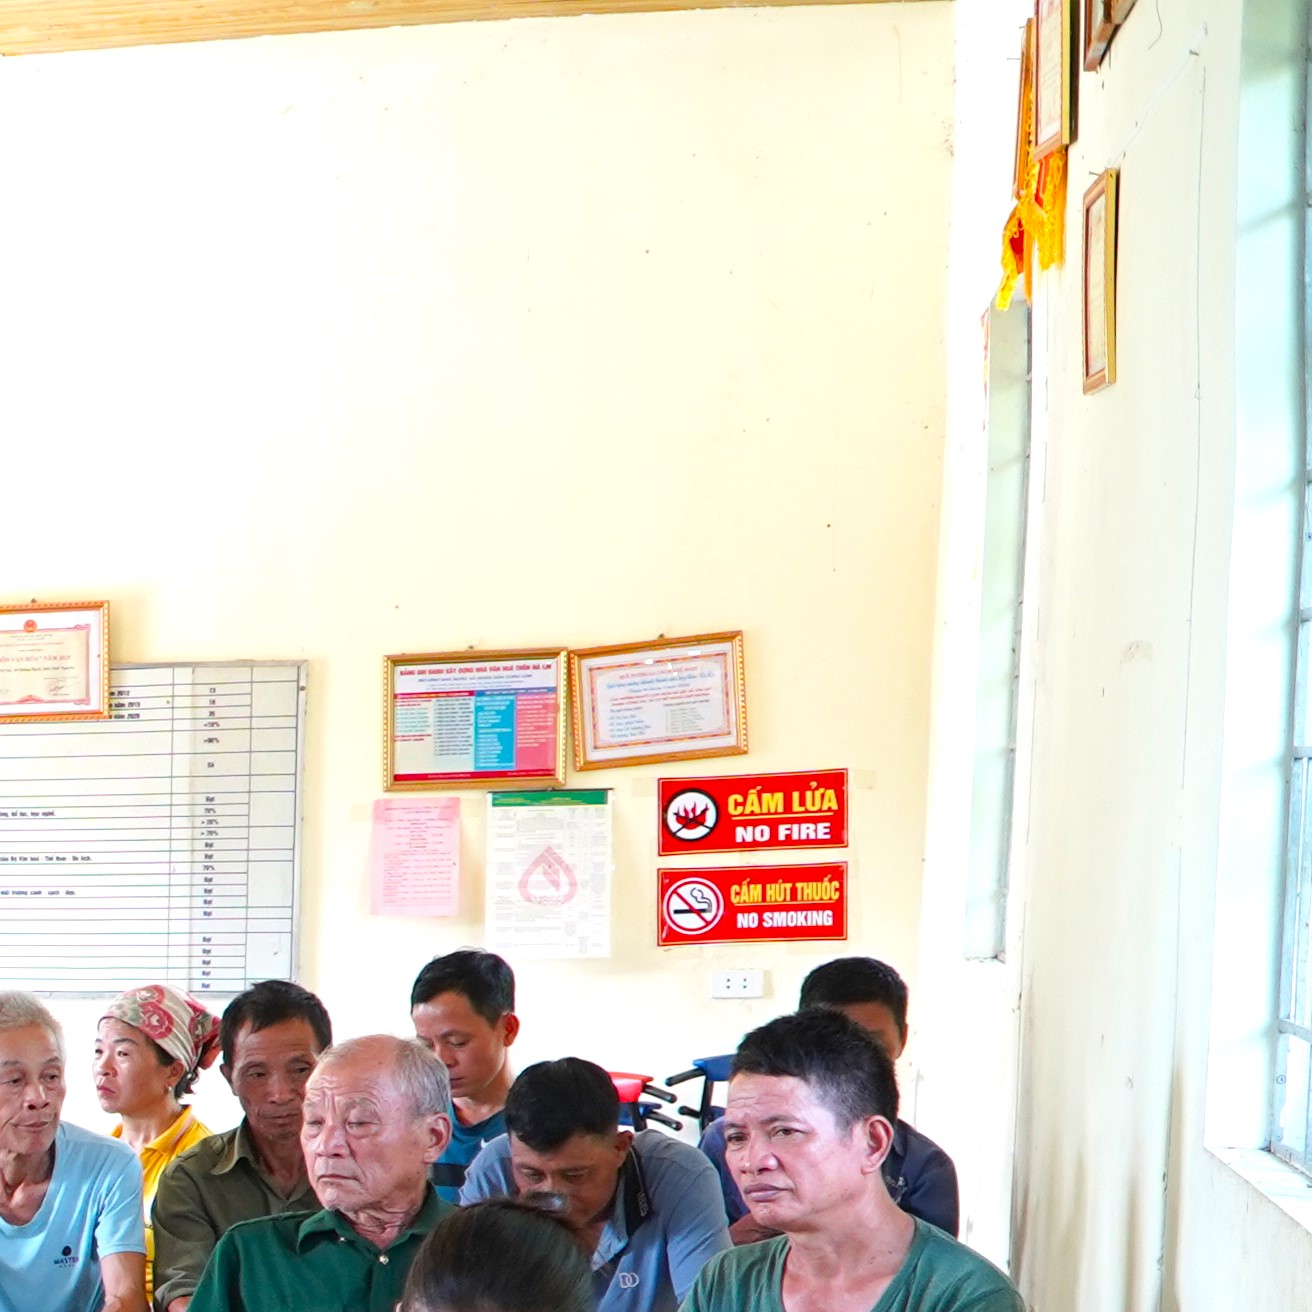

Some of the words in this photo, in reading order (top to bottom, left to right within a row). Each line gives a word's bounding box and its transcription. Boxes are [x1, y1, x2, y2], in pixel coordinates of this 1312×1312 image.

[727, 786, 784, 815] CẤM
[792, 781, 838, 812] LỬA
[735, 825, 770, 843] NO
[778, 822, 831, 841] FIRE
[730, 878, 762, 904] CẤM
[766, 879, 792, 903] HÚT
[795, 874, 840, 902] THUỐC
[737, 912, 758, 928] NO
[763, 910, 833, 927] SMOKING
